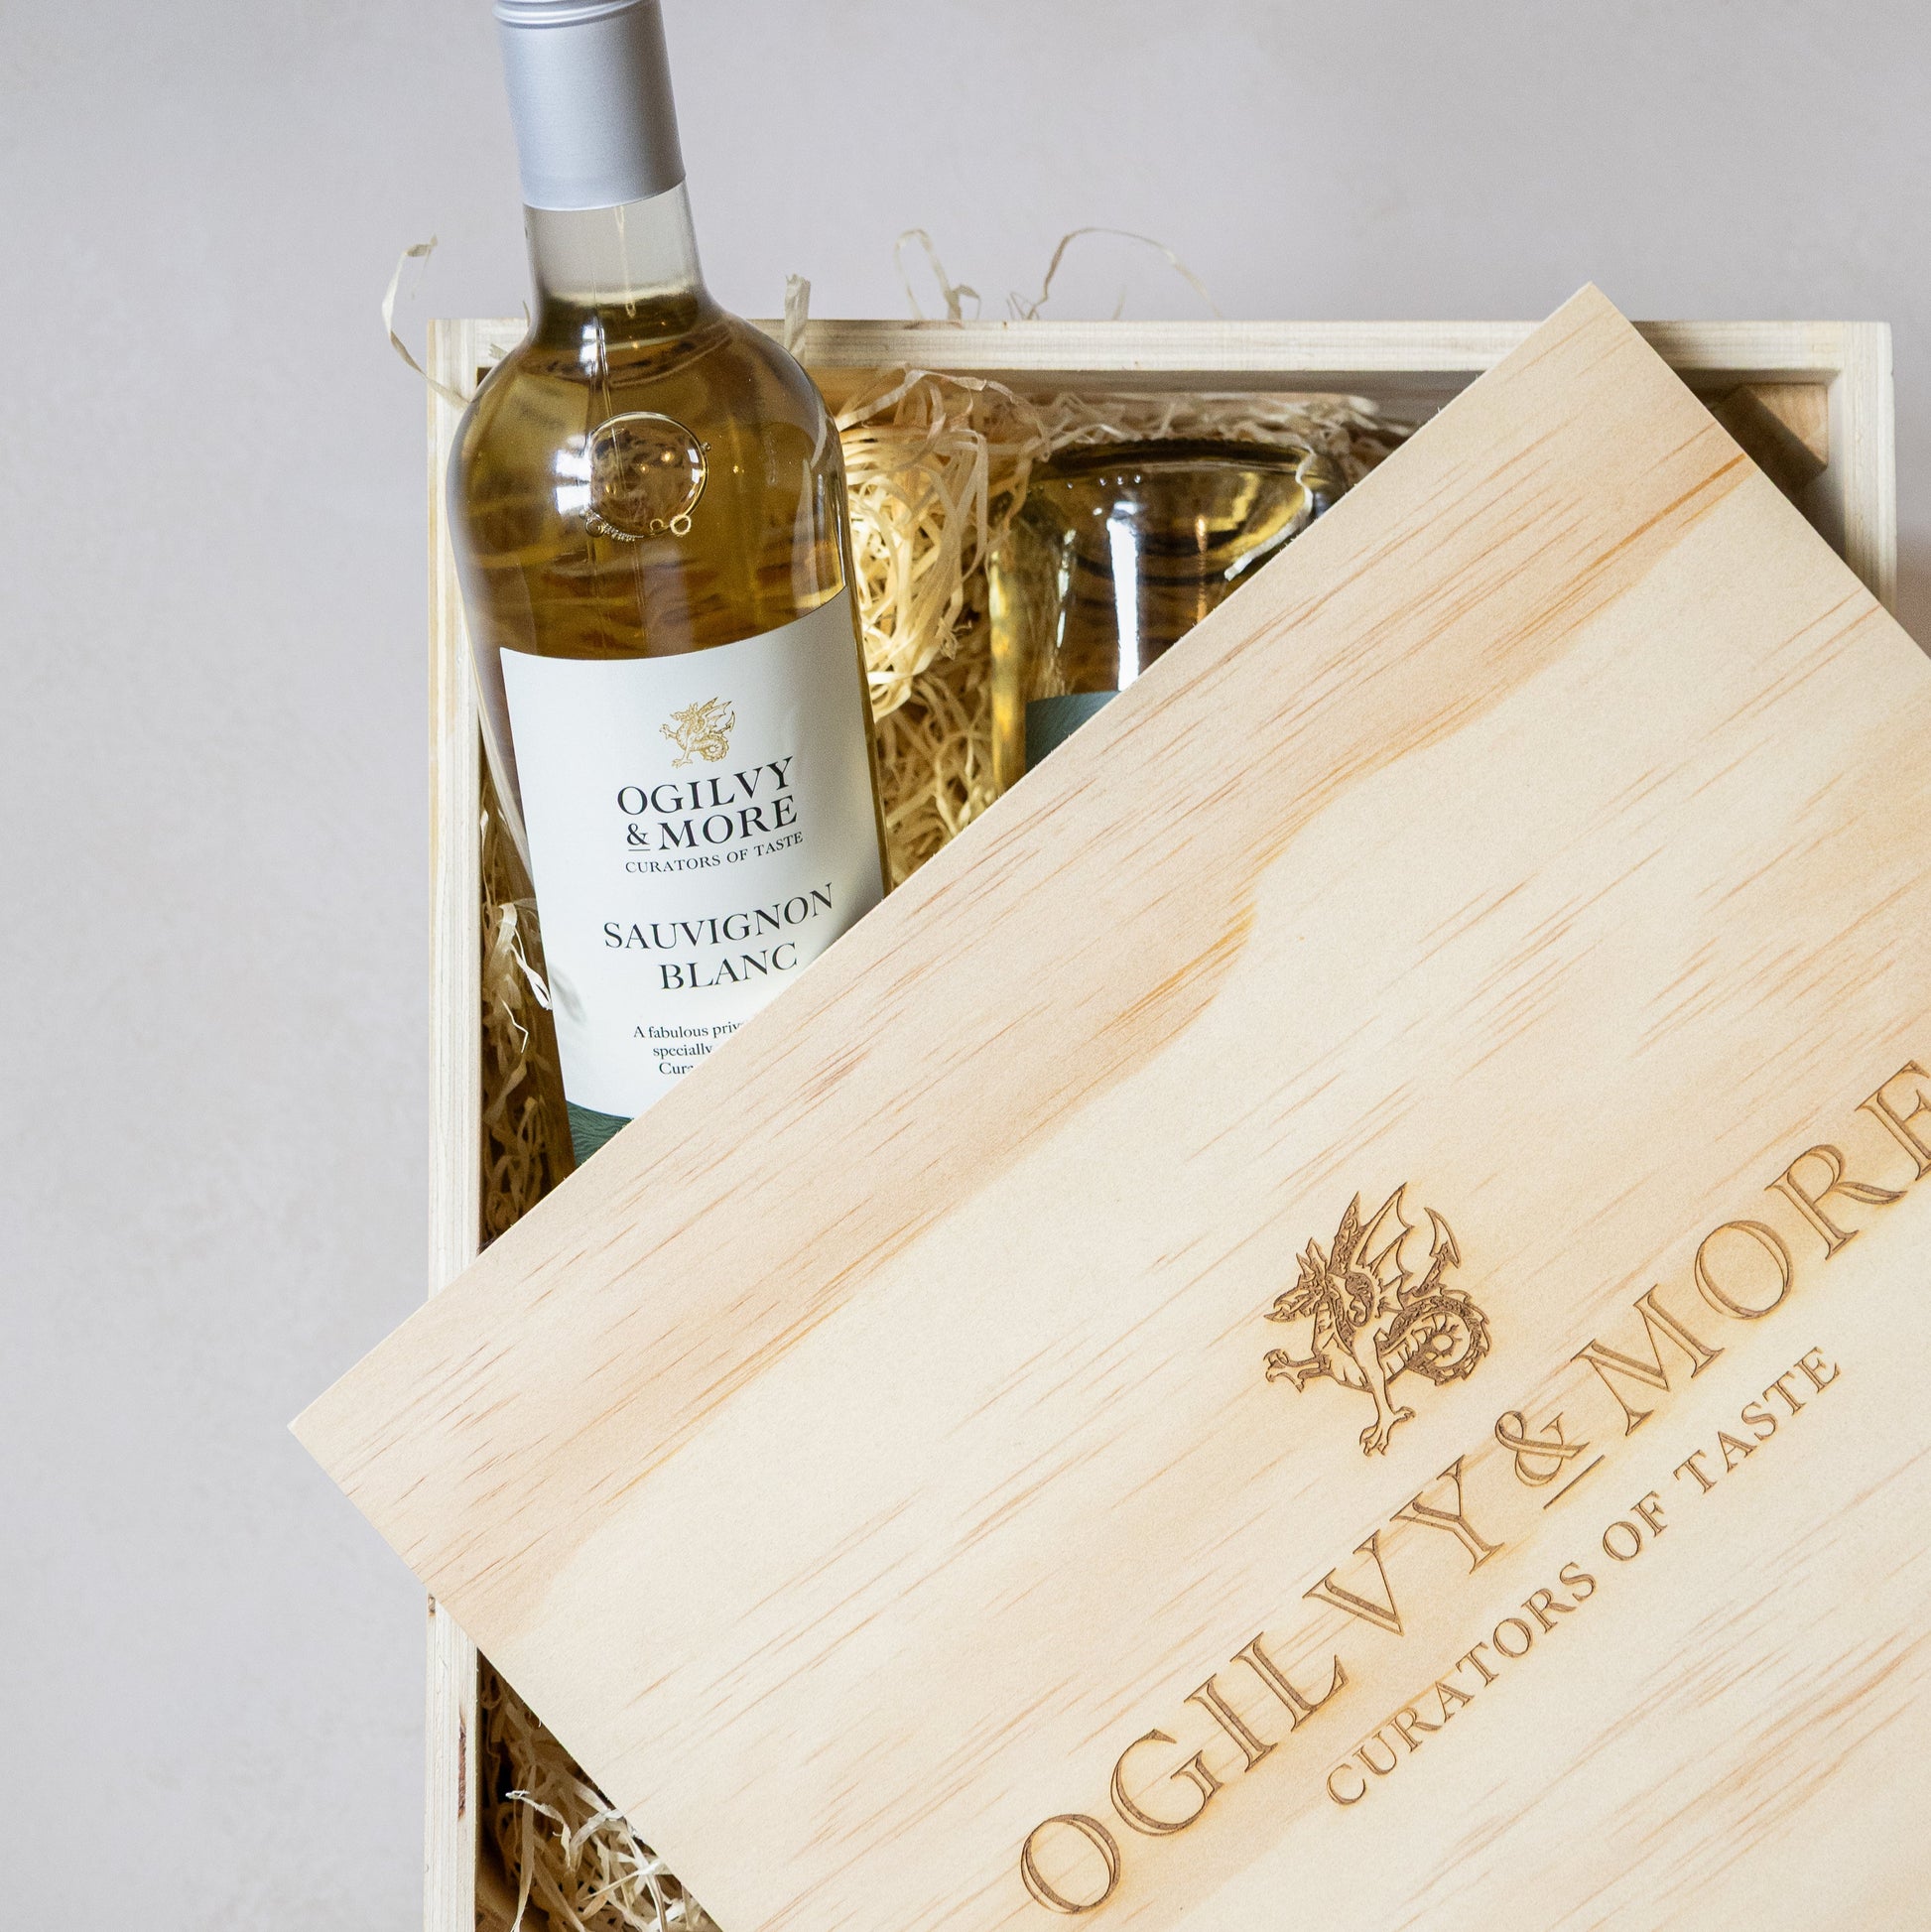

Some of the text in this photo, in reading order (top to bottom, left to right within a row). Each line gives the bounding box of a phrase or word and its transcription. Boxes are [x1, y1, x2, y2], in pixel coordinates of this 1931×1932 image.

[617, 756, 793, 815] OGILVY
[626, 795, 798, 851] & MORE
[625, 831, 804, 873] CURATORS OF TASTE
[603, 882, 833, 949] SAUVIGNON
[659, 942, 797, 989] BLANC
[634, 1026, 645, 1038] A
[648, 1026, 708, 1039] fabulous
[1020, 1060, 1931, 1916] OGILVY & MORE
[1326, 1347, 1842, 1806] CURATORS OF TASTE
